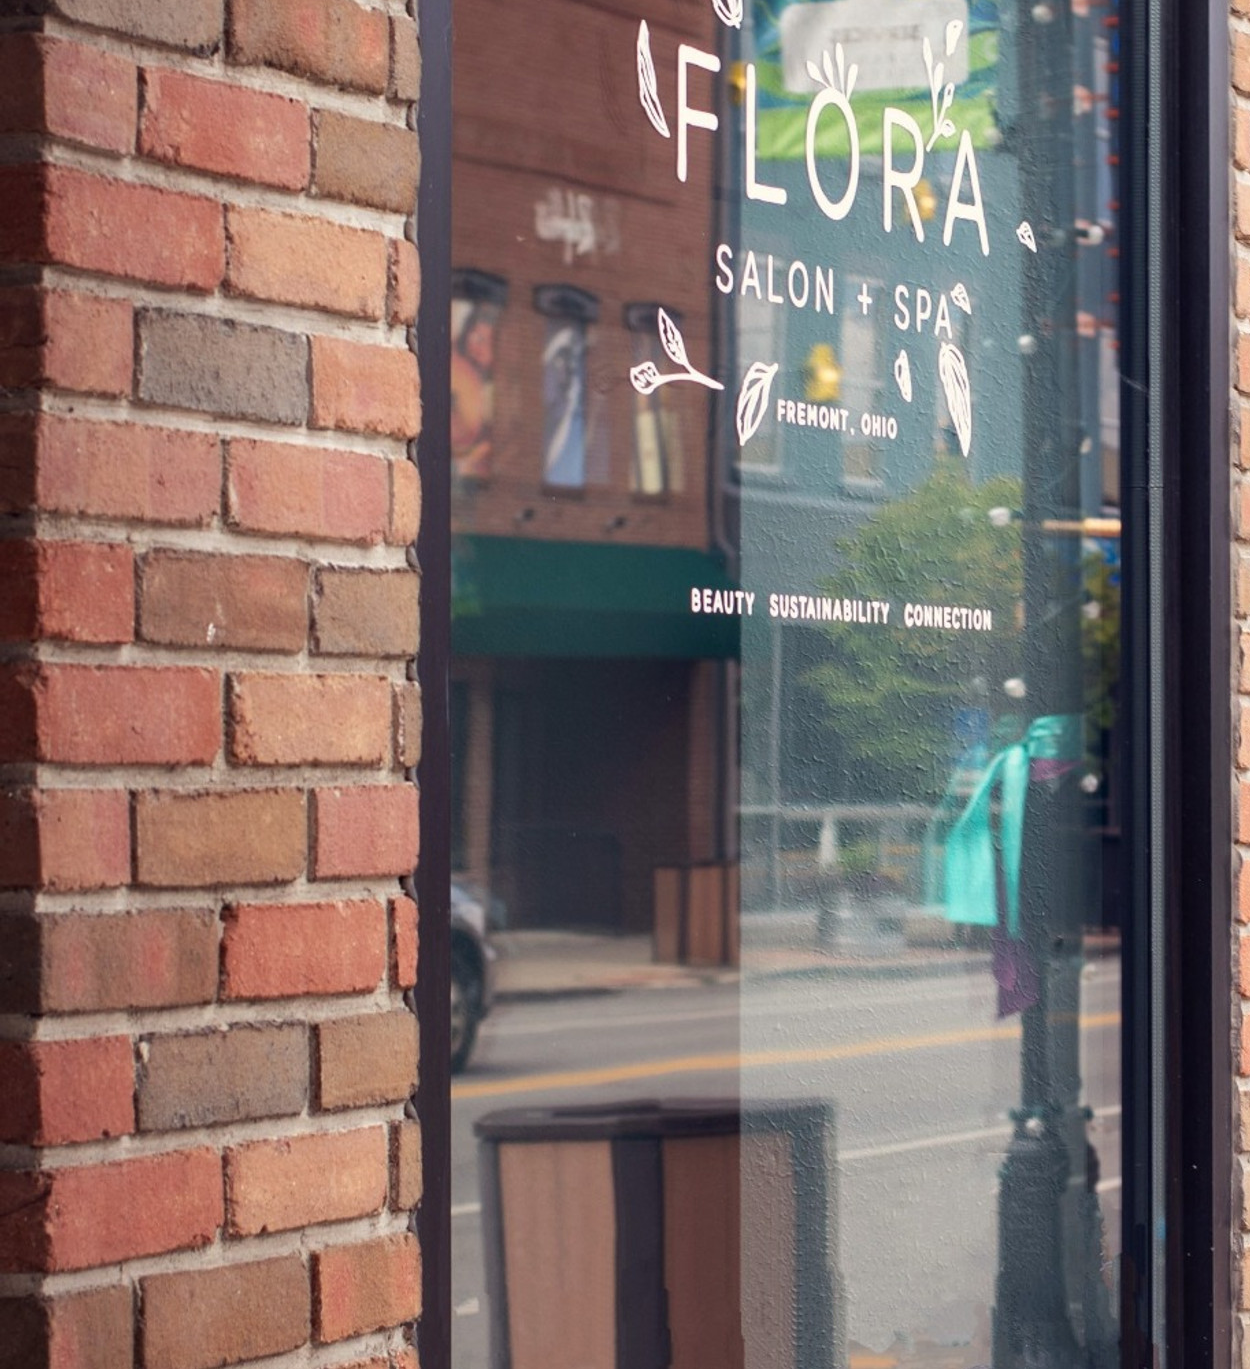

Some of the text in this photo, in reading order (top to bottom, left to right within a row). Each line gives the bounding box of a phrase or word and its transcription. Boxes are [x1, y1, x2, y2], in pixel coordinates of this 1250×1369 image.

[677, 44, 989, 256] FLORA
[716, 244, 953, 339] SALON + SPA
[777, 398, 898, 440] FREMONT, OHIO
[690, 588, 992, 631] BEAUTY SUSTAINABILITY CONNECTION
